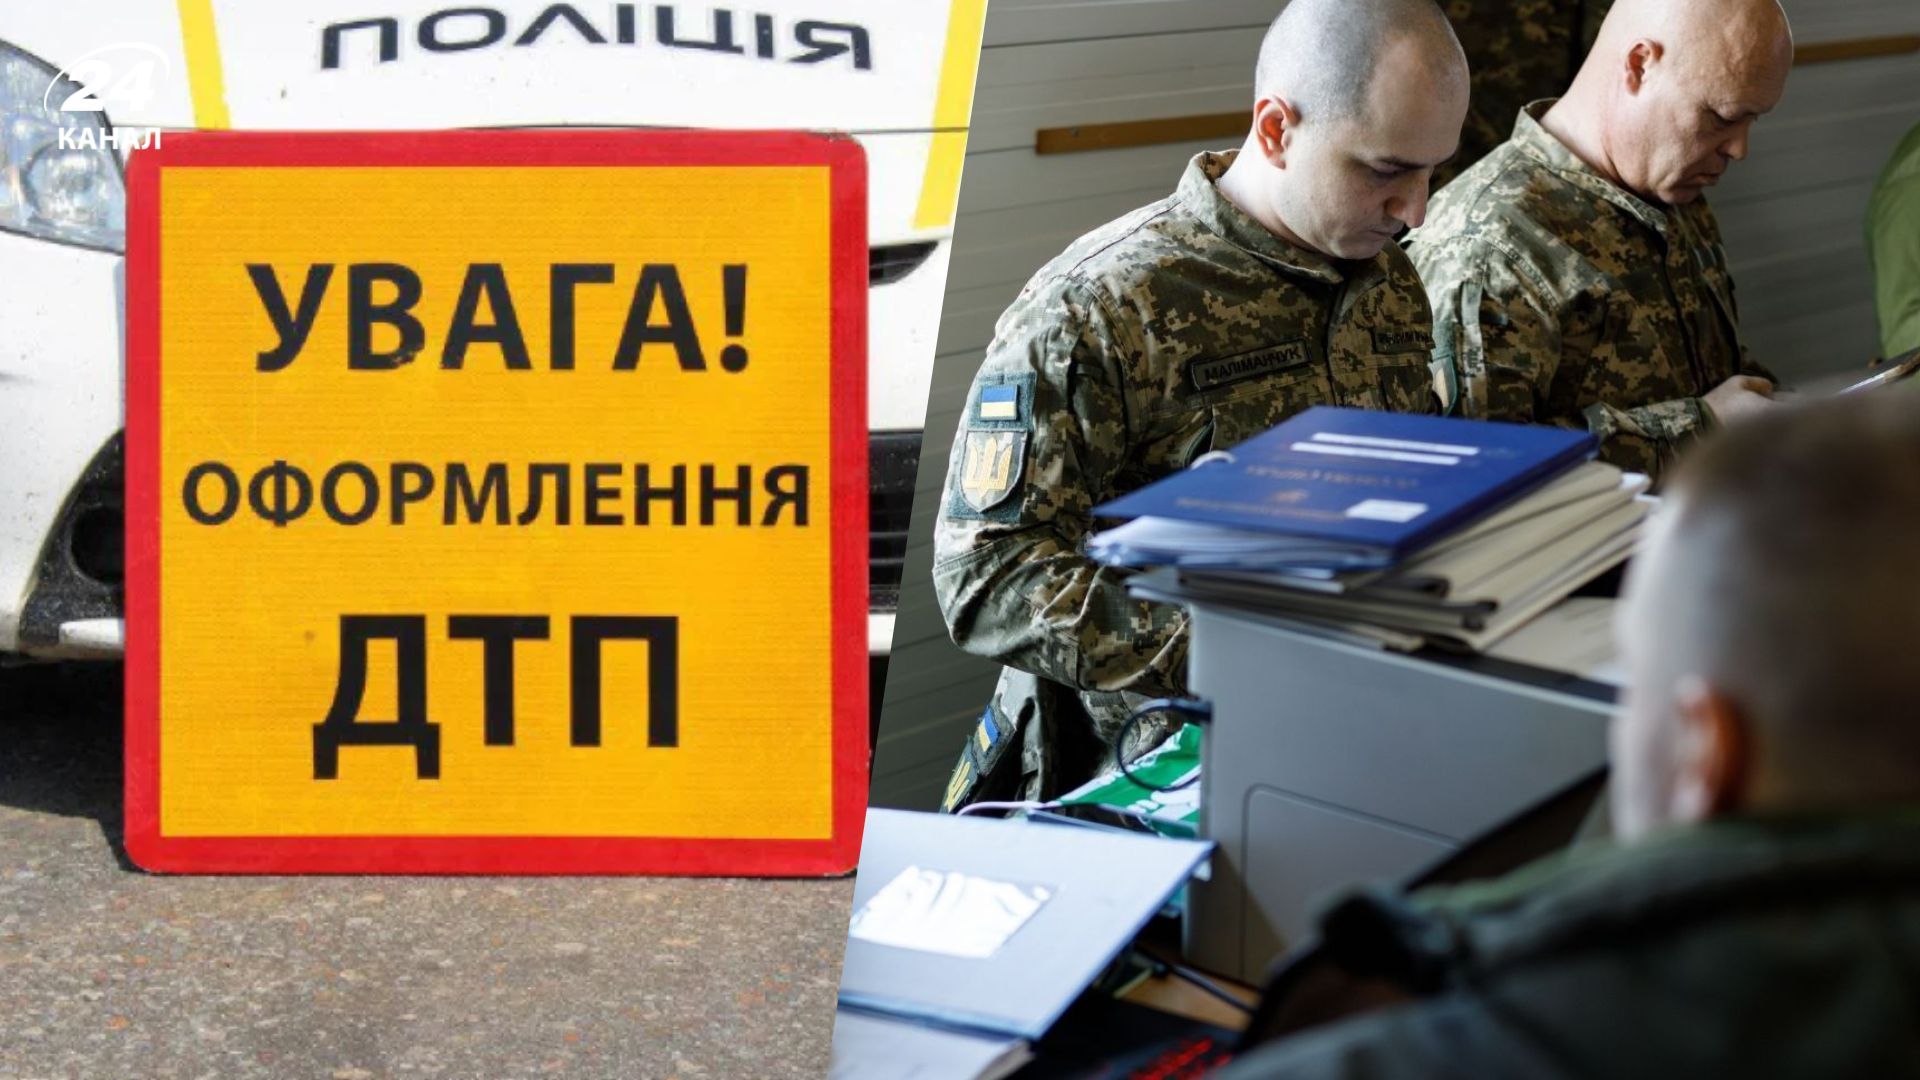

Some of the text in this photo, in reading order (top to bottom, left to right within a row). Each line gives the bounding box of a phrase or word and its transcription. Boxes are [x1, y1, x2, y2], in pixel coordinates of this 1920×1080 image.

[321, 3, 872, 70] ПОЛІЦІЯ
[247, 263, 748, 373] УВАГА!
[182, 460, 809, 527] ОФОРМЛЕННЯ
[313, 614, 679, 780] ДТП
